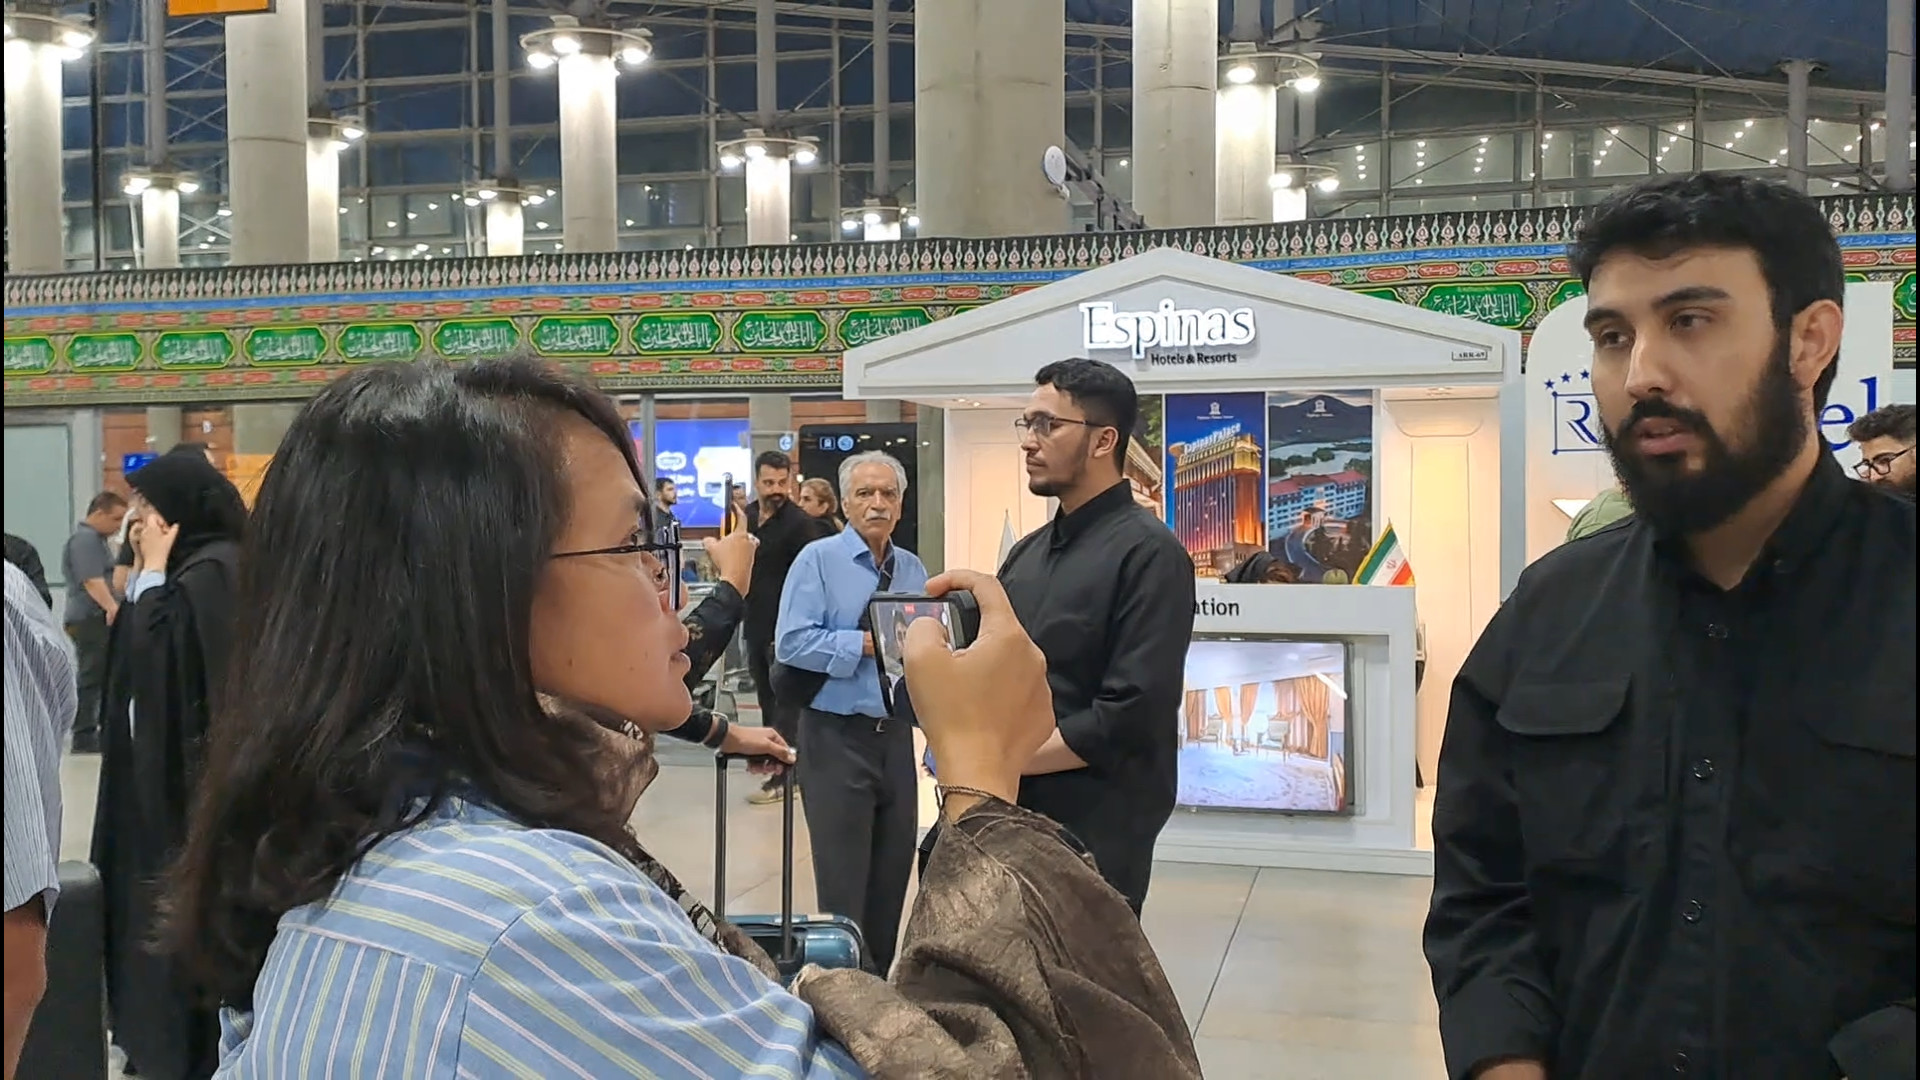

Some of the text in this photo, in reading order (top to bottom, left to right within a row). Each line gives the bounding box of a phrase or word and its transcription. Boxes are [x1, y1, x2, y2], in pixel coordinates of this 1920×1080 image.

[1081, 299, 1255, 358] Espinas
[1151, 352, 1237, 365] Hotels & Resorts
